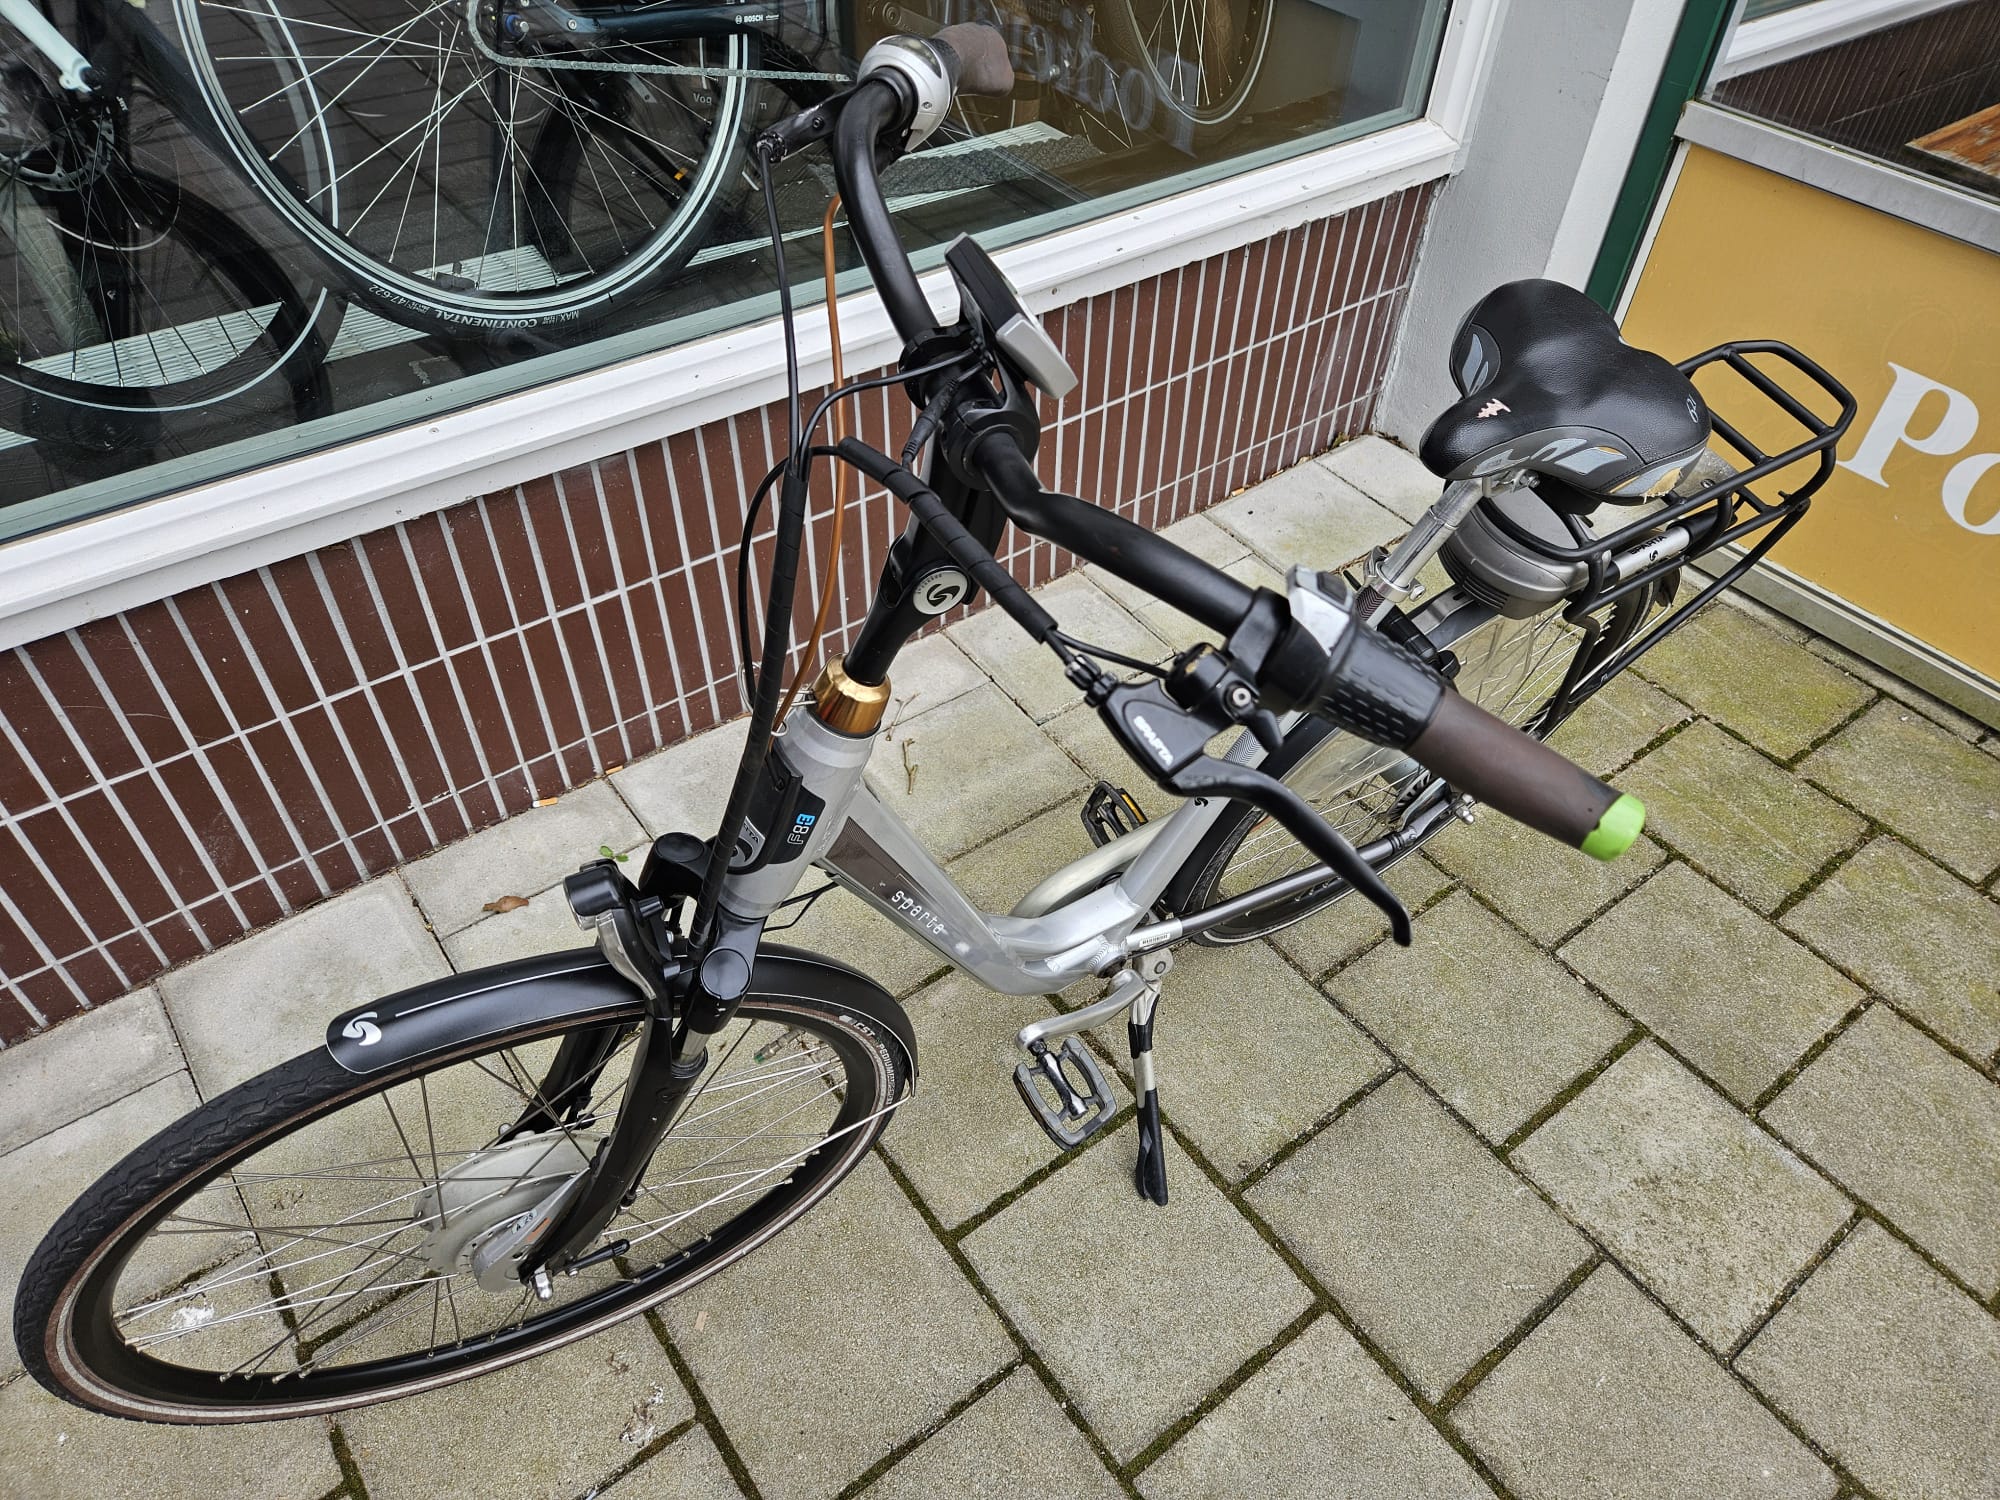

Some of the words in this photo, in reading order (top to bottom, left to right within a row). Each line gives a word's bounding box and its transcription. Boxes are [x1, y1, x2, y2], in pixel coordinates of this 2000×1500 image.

[743, 14, 764, 23] BOSCH
[368, 284, 405, 305] 47-622
[434, 309, 538, 329] CONTINENTAL
[1836, 361, 2000, 535] Po
[1628, 535, 1668, 555] SPARTA
[1134, 715, 1174, 766] SPARTA
[891, 890, 945, 935] sparta
[853, 1022, 876, 1038] CST
[879, 1043, 895, 1075] PEDIUM
